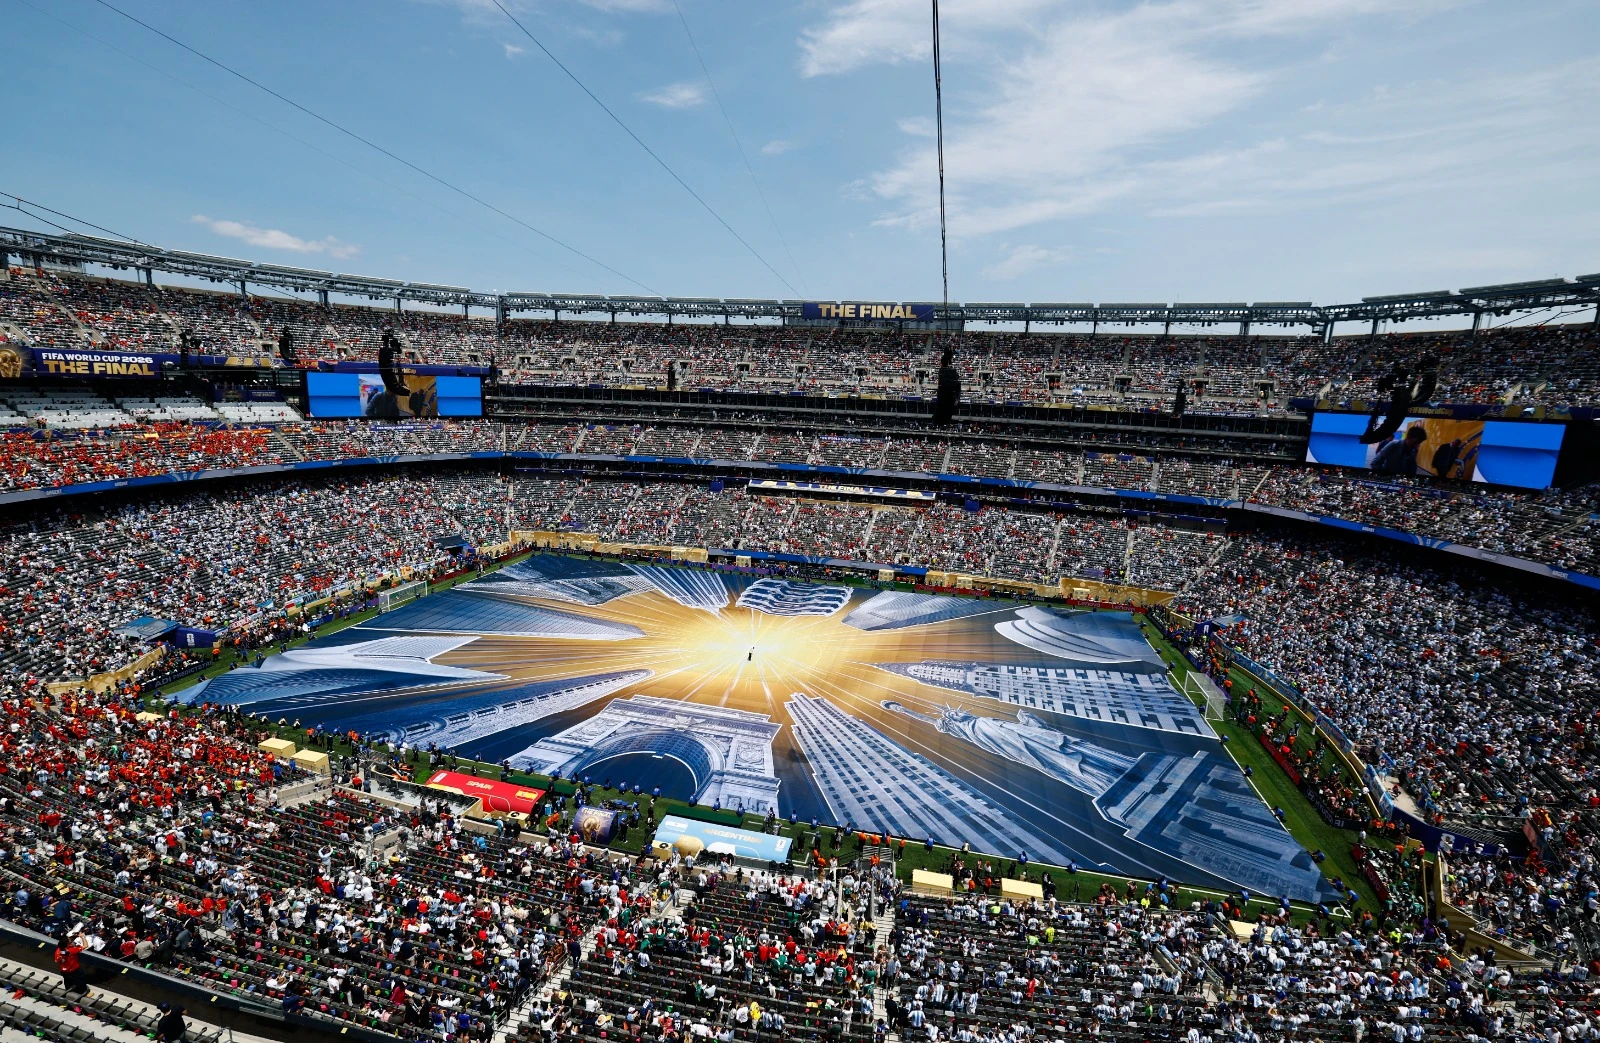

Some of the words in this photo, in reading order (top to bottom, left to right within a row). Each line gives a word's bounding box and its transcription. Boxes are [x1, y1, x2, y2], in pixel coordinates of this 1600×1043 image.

[818, 303, 857, 318] THE
[859, 304, 918, 319] FINAL
[42, 352, 65, 361] FIFA
[65, 353, 100, 362] WORLD
[102, 355, 120, 363] CUP
[121, 355, 154, 364] 2026
[44, 360, 90, 374] THE
[94, 361, 155, 376] FINAL
[864, 577, 895, 587] aramco
[1077, 600, 1101, 608] Lenovo
[1111, 603, 1136, 613] Lenovo
[154, 676, 172, 688] ADI
[466, 780, 495, 790] SPAIN
[593, 810, 612, 818] FINAL
[704, 827, 762, 844] ARGENTINA
